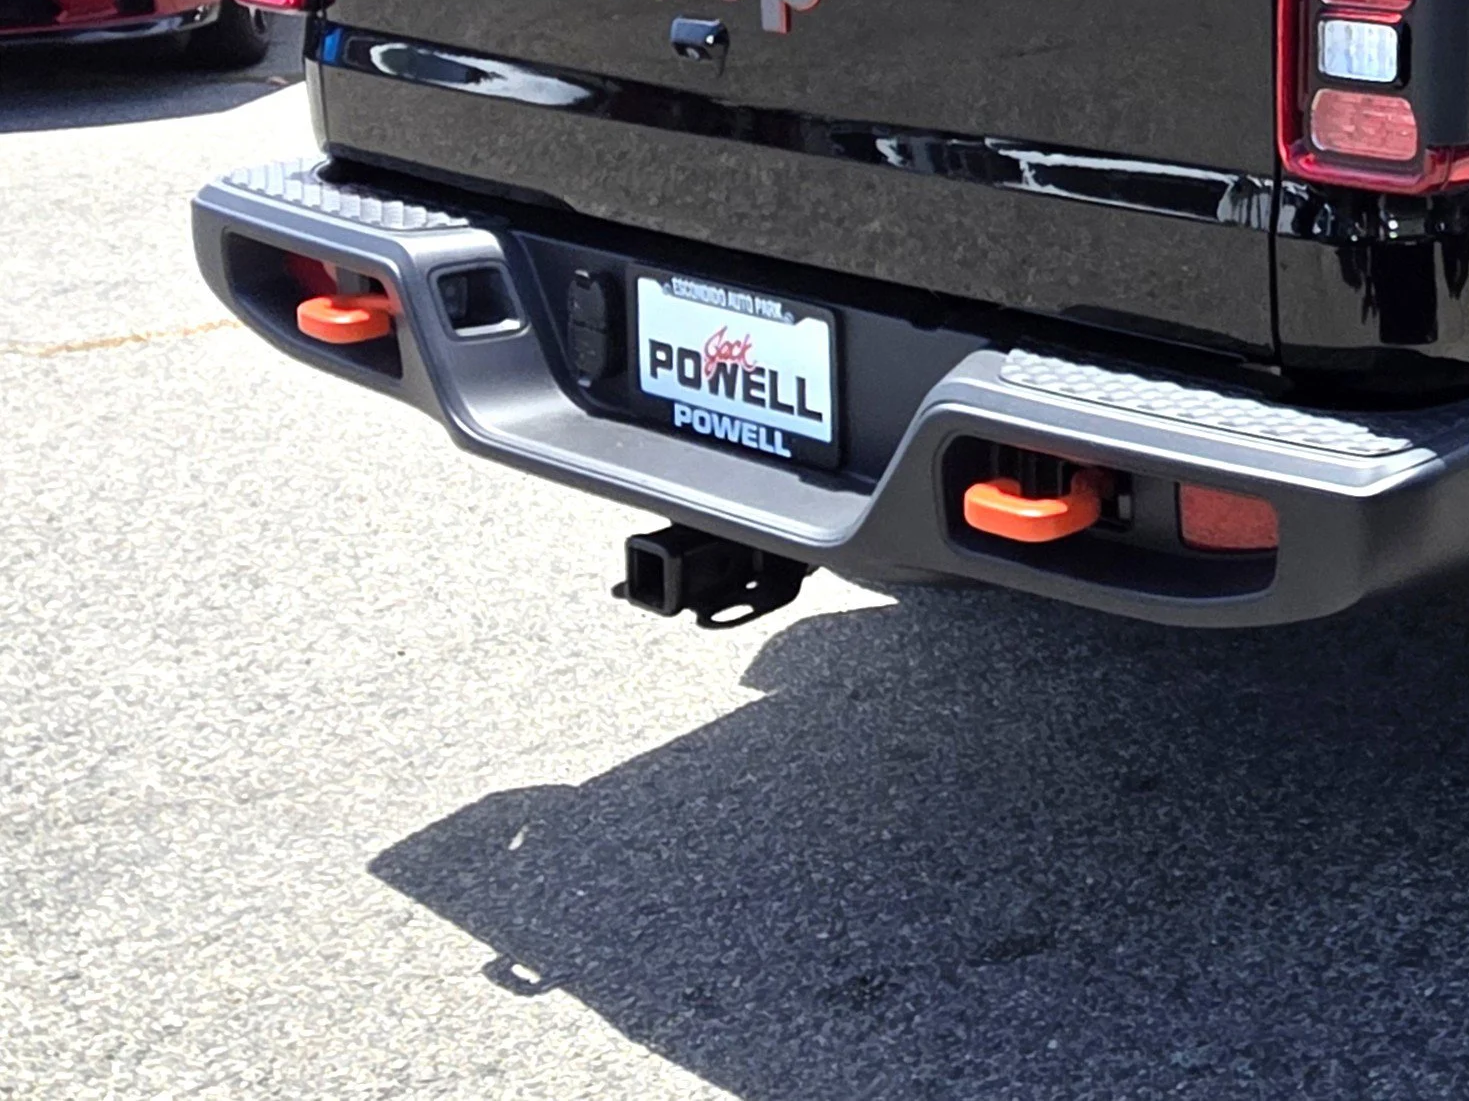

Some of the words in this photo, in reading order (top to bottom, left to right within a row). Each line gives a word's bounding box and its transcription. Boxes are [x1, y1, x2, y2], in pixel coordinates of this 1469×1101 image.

[671, 277, 727, 307] ESCONDIDO
[727, 291, 753, 314] AUTO
[754, 296, 783, 319] PARK
[648, 338, 823, 423] POWELL
[673, 403, 791, 457] POWELL
